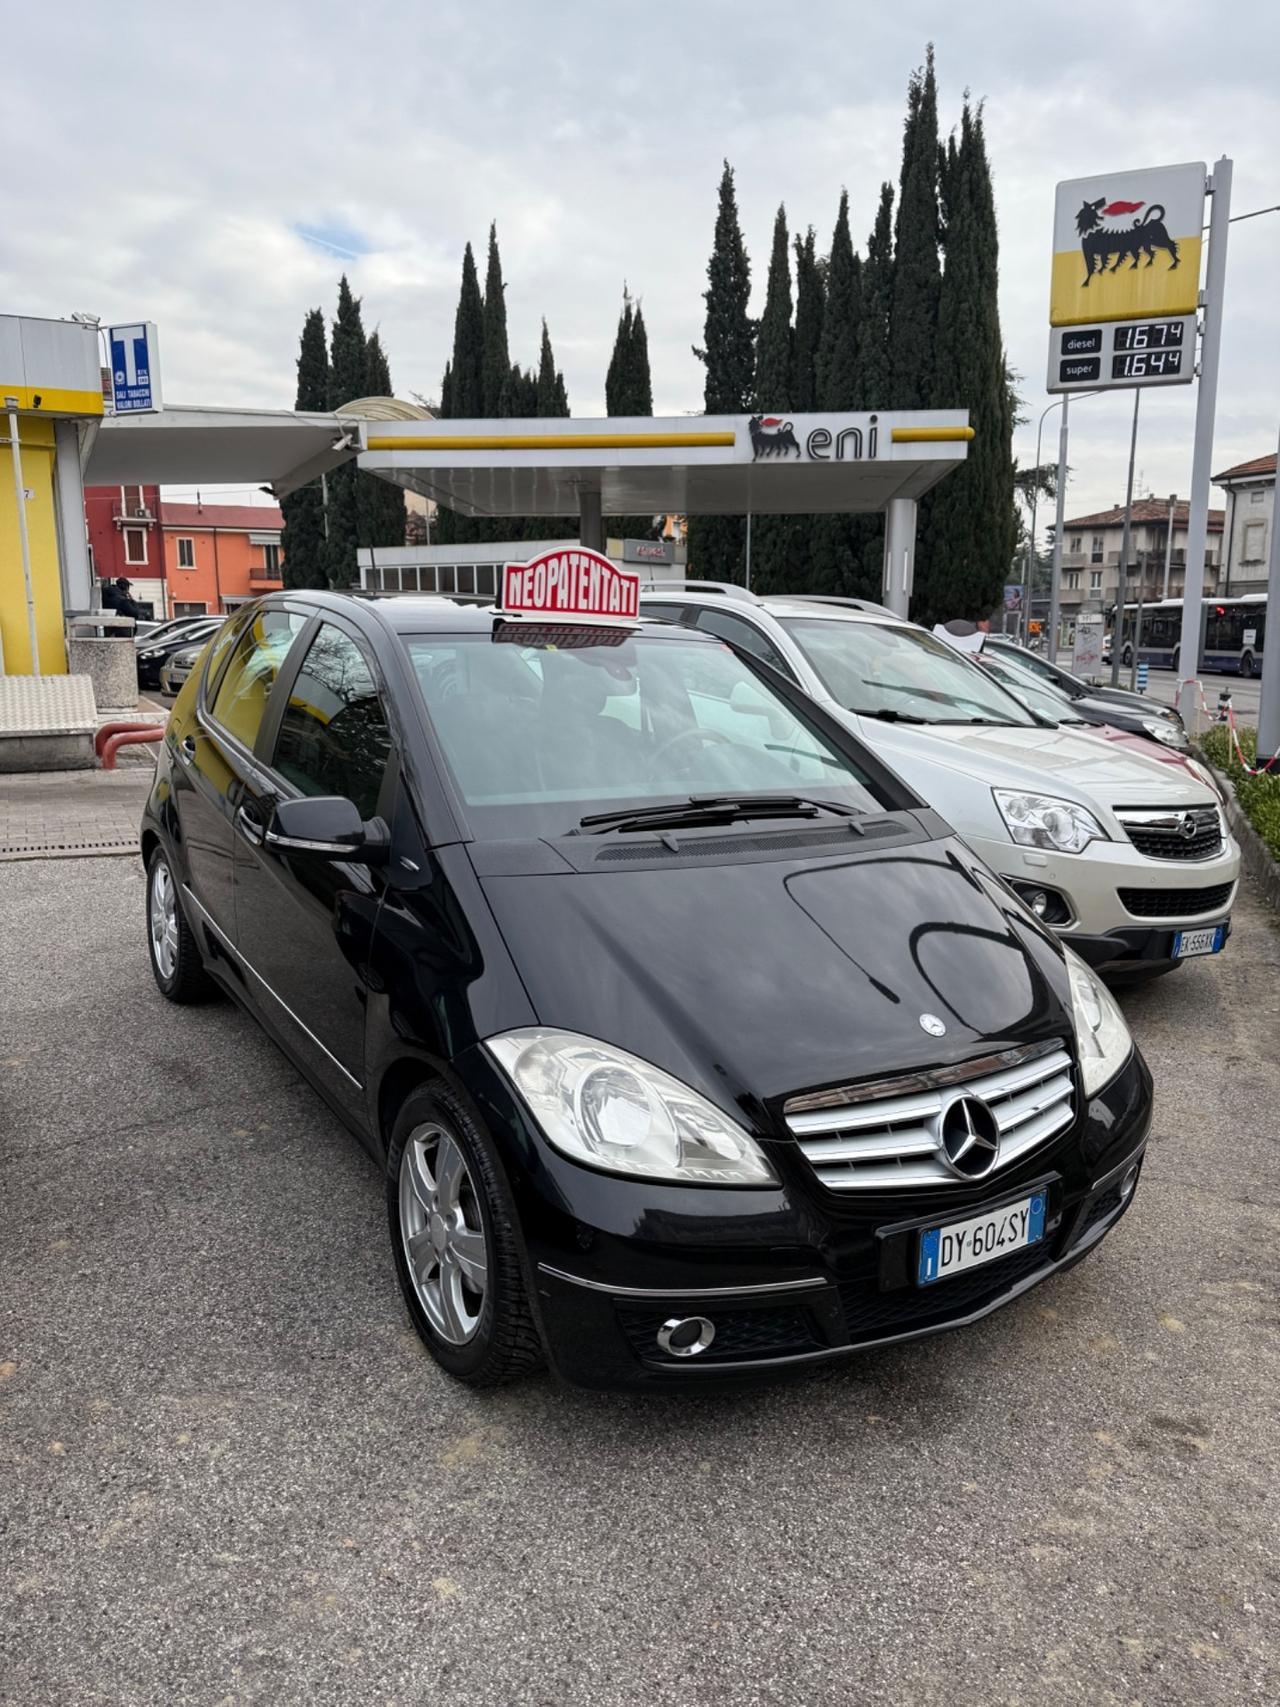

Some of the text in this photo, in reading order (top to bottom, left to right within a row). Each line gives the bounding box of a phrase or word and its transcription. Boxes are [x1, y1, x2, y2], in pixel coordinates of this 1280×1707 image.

[112, 326, 145, 387] T
[1067, 338, 1096, 350] diesel
[1066, 364, 1093, 377] super
[116, 388, 150, 400] SALI TABACCHI
[807, 414, 879, 461] eni
[508, 553, 636, 614] NEOPATENTATI
